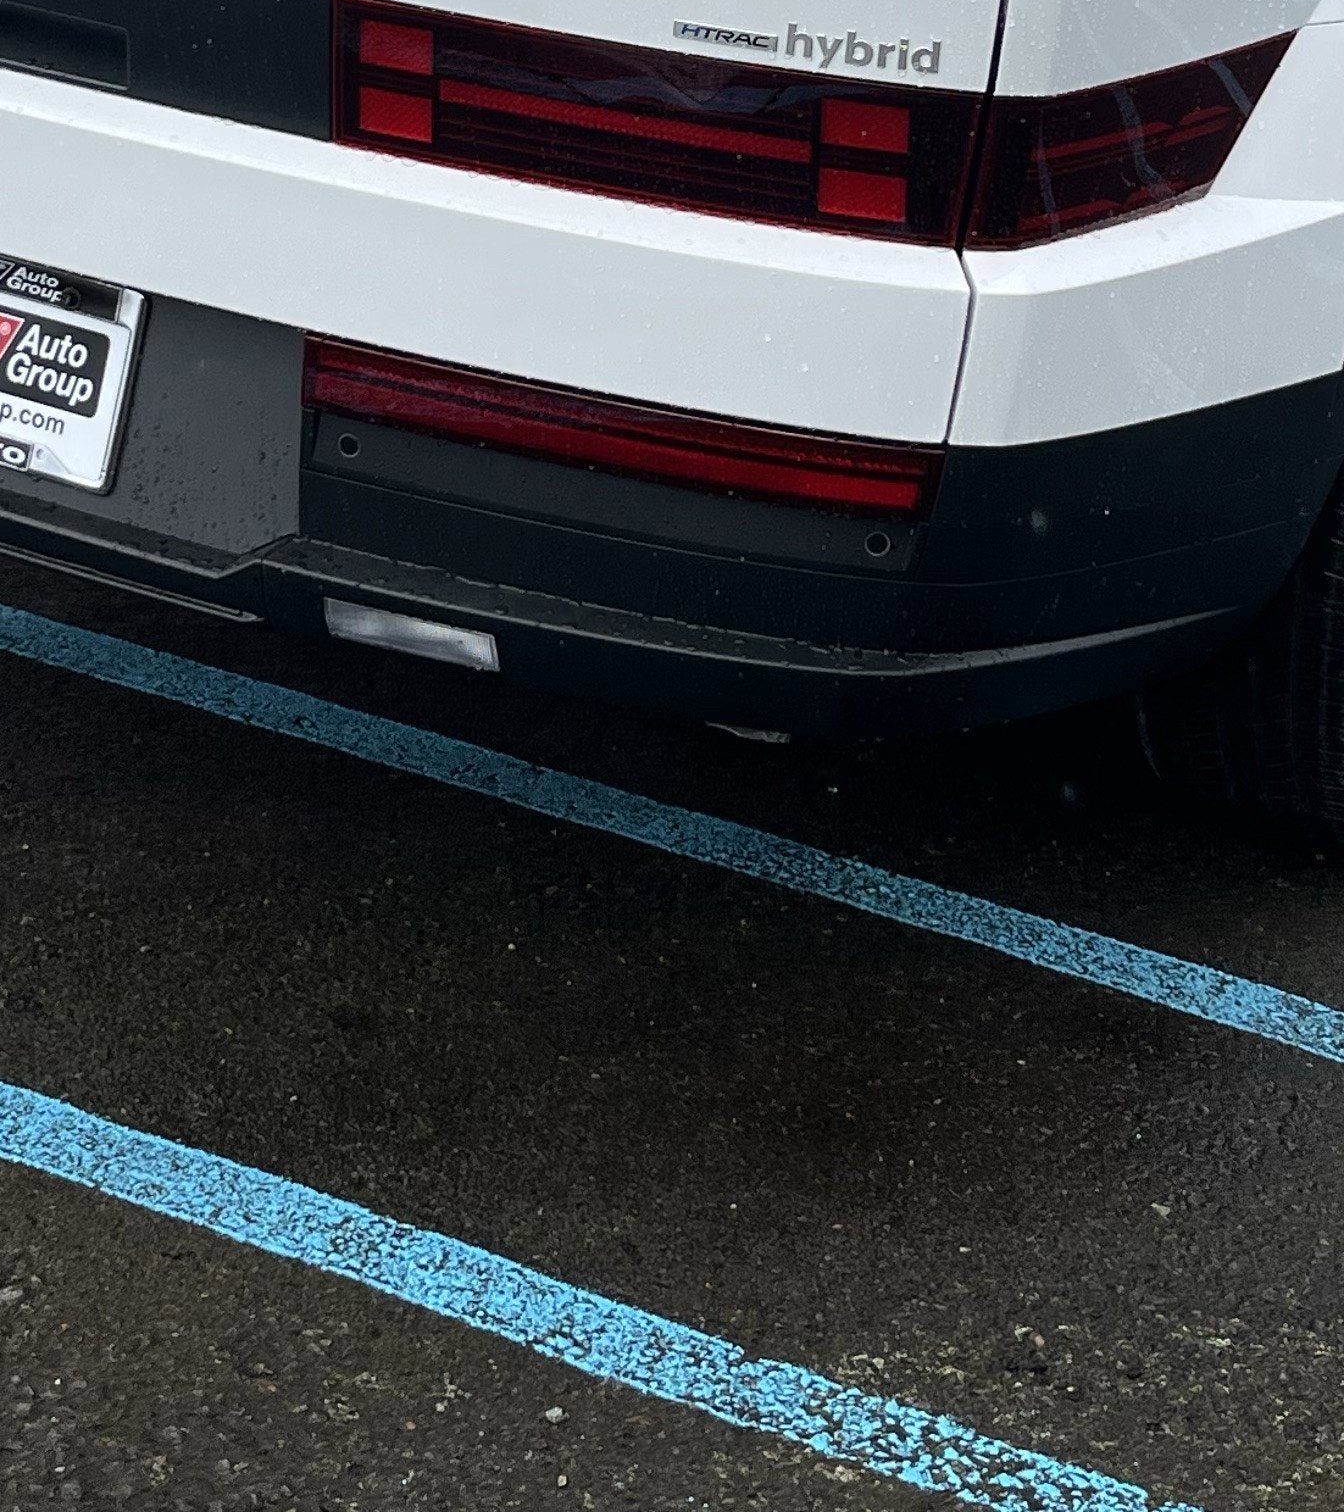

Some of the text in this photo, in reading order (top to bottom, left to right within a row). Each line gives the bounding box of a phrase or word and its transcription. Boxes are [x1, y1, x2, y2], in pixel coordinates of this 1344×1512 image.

[680, 22, 942, 74] HTRAC hybrid
[6, 275, 63, 303] Group
[13, 266, 59, 288] Auto
[17, 323, 89, 368] Auto
[6, 352, 94, 407] Group
